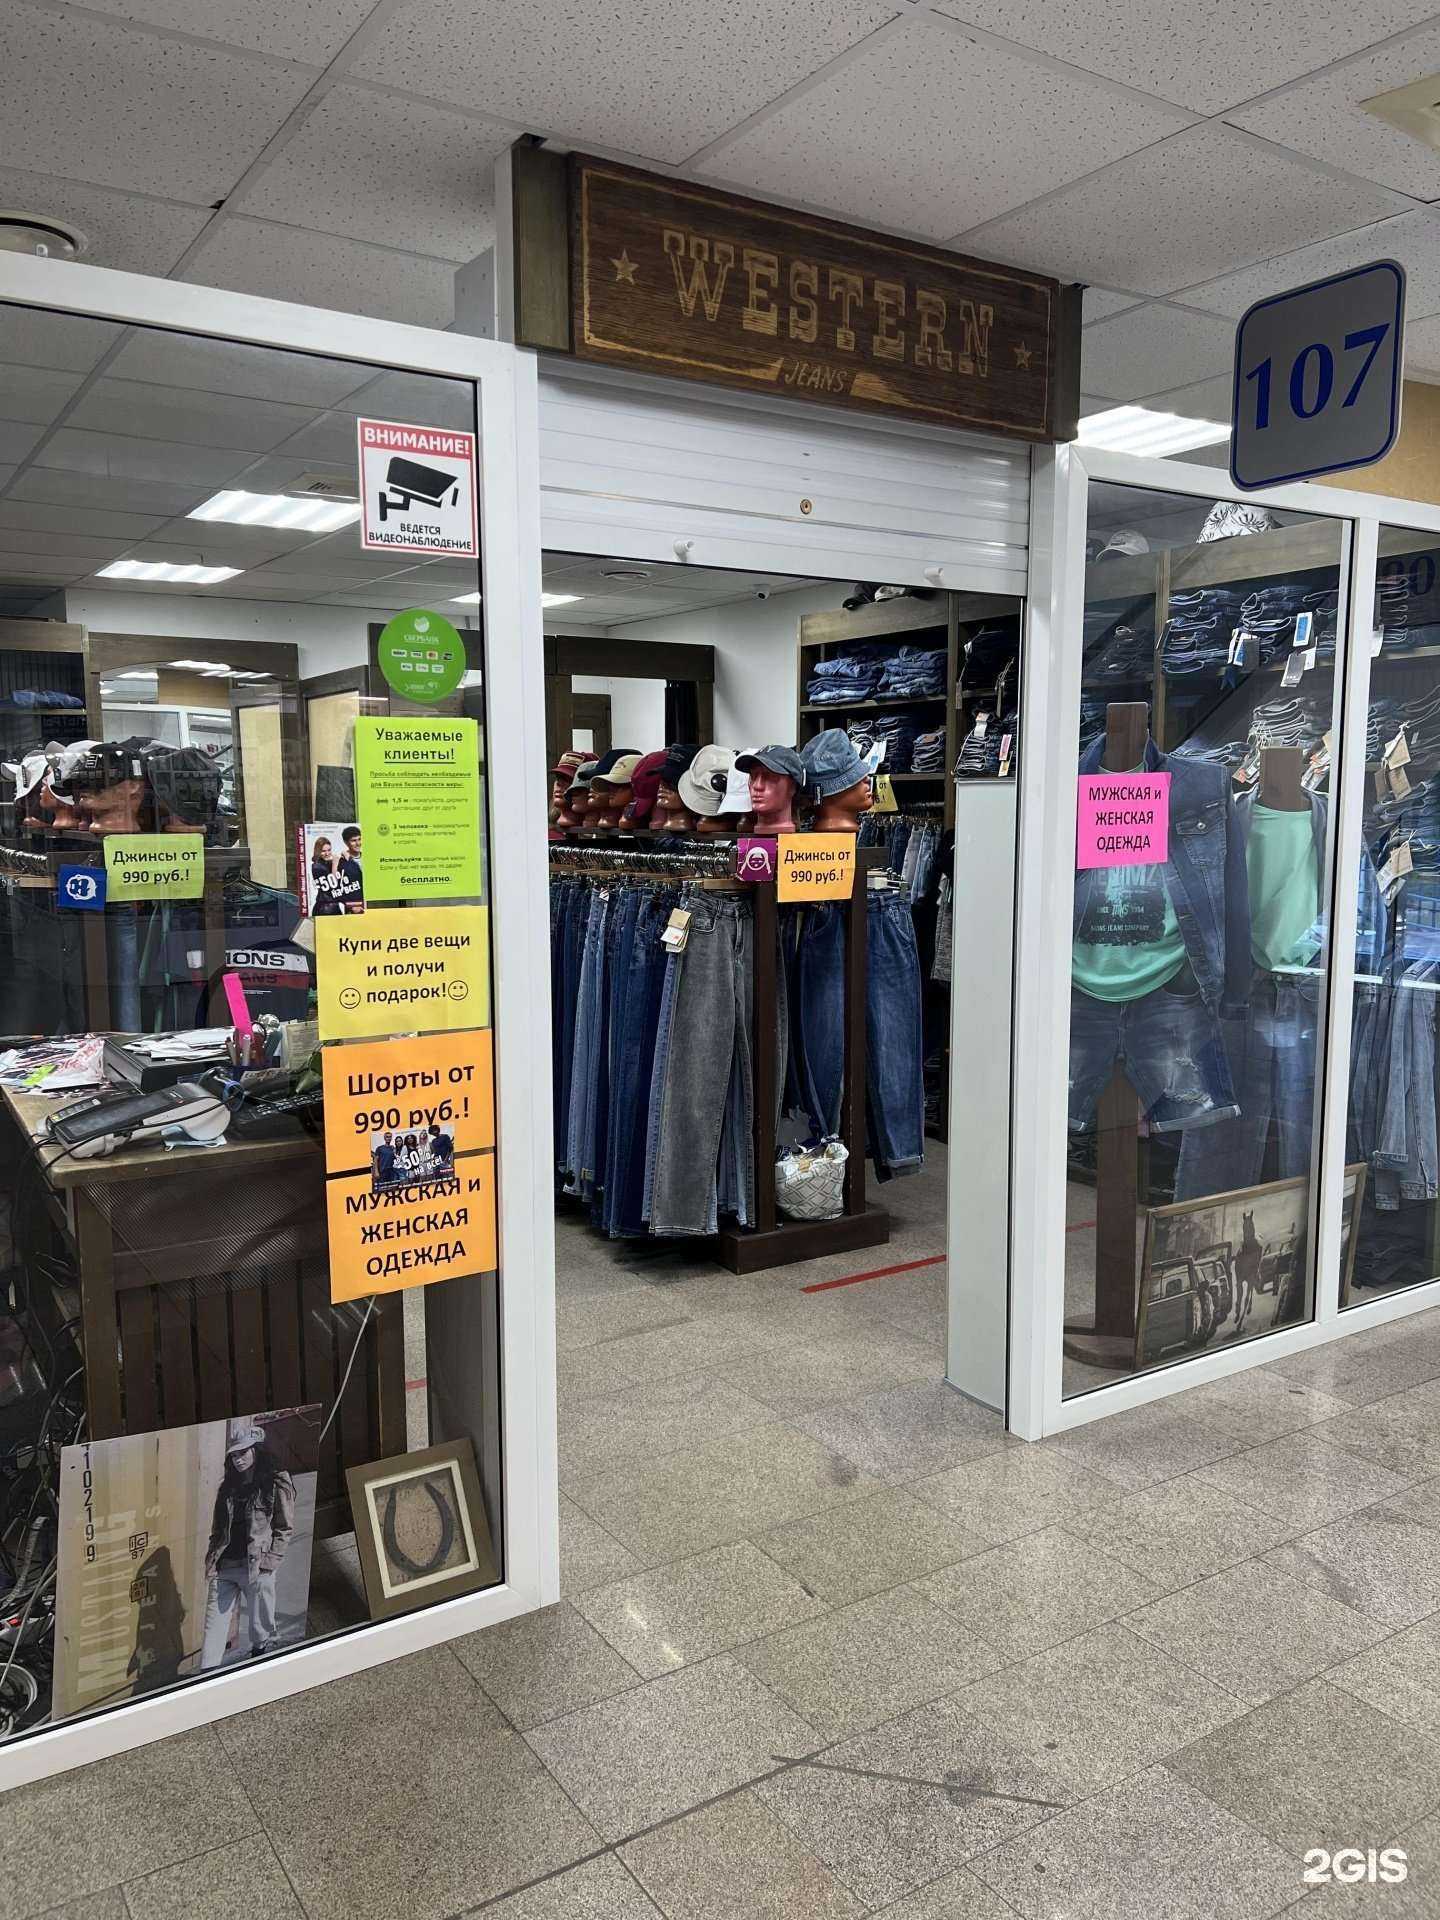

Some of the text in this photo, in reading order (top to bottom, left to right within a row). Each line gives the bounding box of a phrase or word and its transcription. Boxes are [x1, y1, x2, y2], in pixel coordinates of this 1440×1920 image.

[663, 229, 994, 378] WESTERN
[783, 359, 846, 393] JEANS
[1245, 322, 1391, 431] 107
[364, 427, 470, 454] ВНИМАНИЕ!
[400, 523, 441, 535] ВЕДЕТСЯ
[369, 532, 472, 550] ВИДЕОНАБЛЮДЕНИЕ
[376, 728, 463, 742] Уважаемые
[384, 749, 455, 761] клиенты!
[1089, 786, 1161, 801] МУЖСКАЯ и
[1095, 810, 1154, 826] ЖЕНСКАЯ
[1097, 835, 1151, 853] ОДЕЖДА
[112, 851, 198, 865] Джинсы от
[784, 850, 851, 864] Джинсы от
[123, 869, 189, 885] 990 руб.!
[791, 869, 844, 884] 990 руб.!
[339, 935, 470, 955] Купи две вещи
[367, 961, 445, 977] и получи
[367, 982, 446, 1004] подарок!
[348, 1065, 475, 1097] Шорты от
[354, 1097, 469, 1134] 990 руб.!
[346, 1178, 461, 1215] МУЖСКАЯ
[468, 1178, 481, 1193] и
[361, 1208, 468, 1245] ЖЕНСКАЯ
[366, 1240, 466, 1276] ОДЕЖДА
[76, 1510, 137, 1694] MUSTANG
